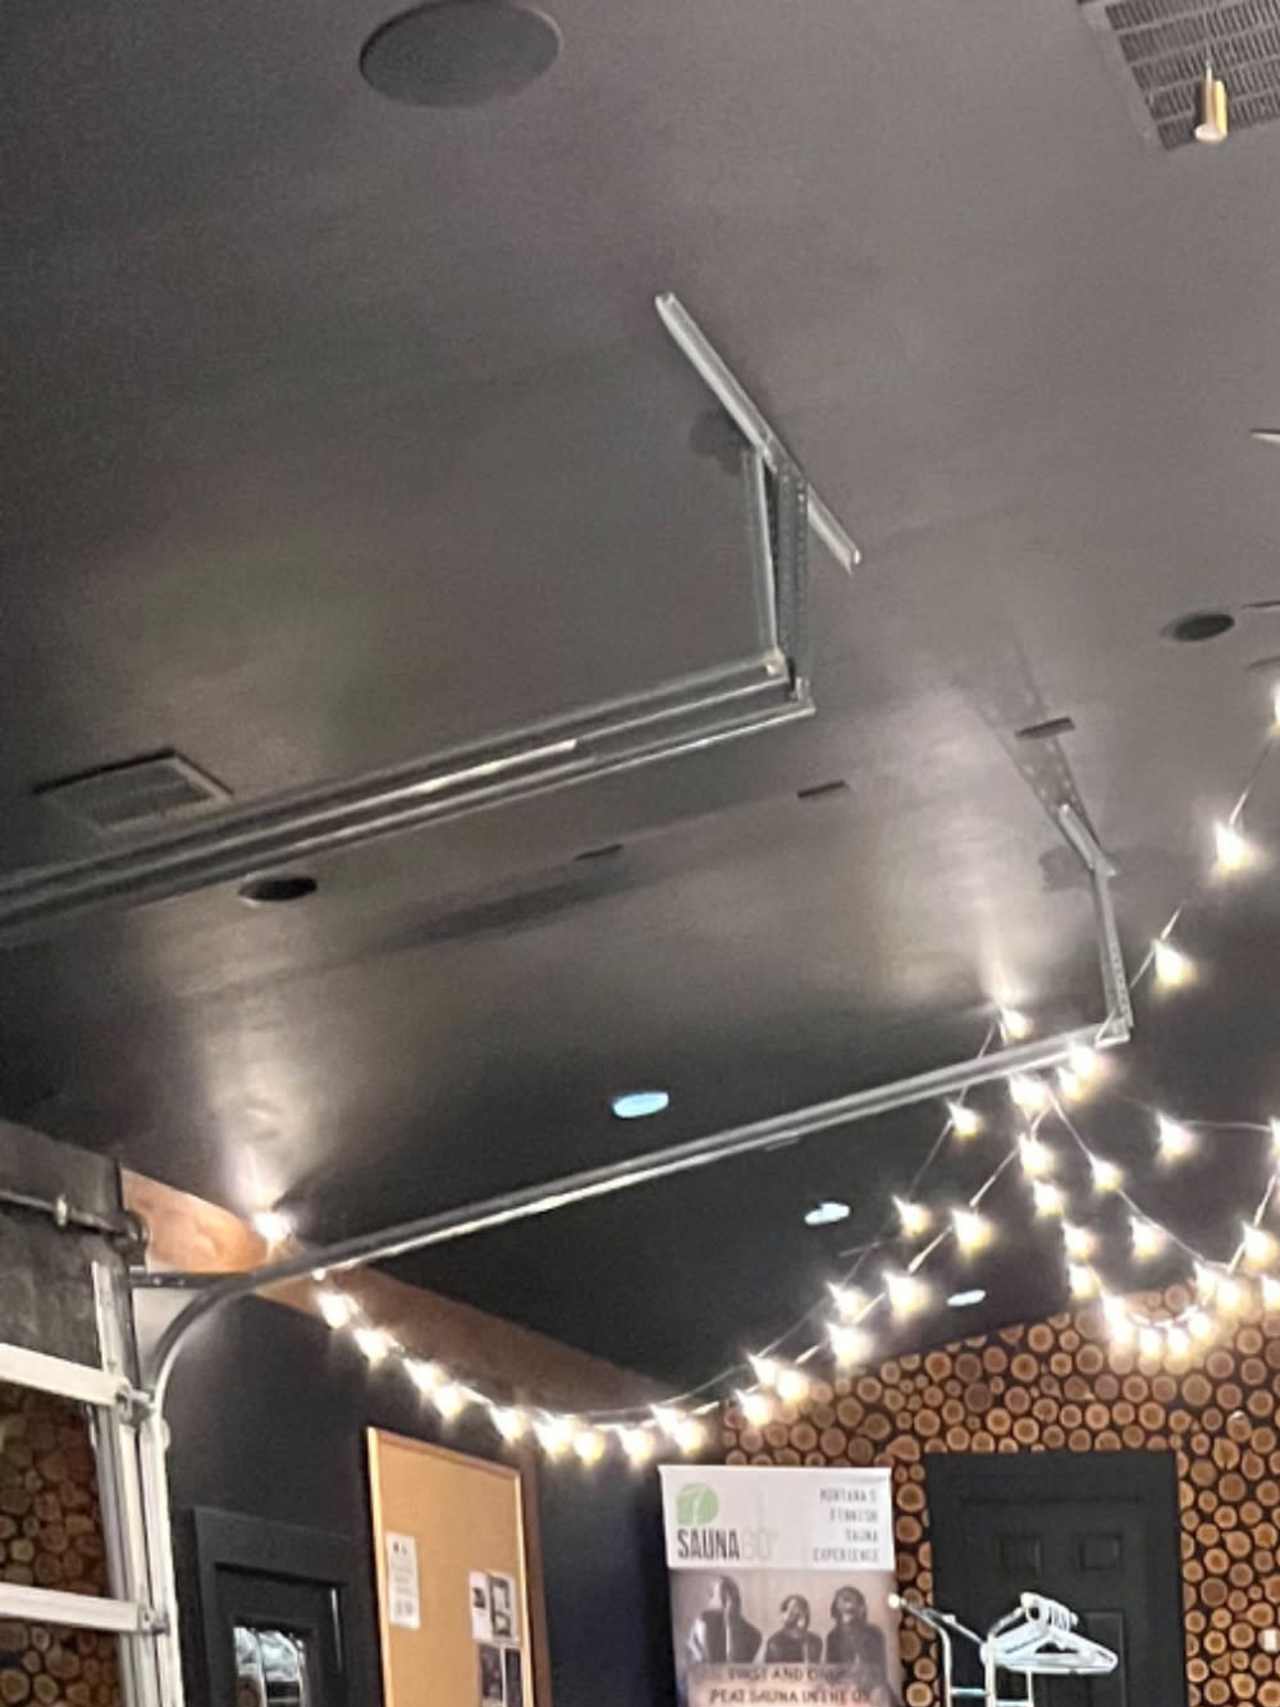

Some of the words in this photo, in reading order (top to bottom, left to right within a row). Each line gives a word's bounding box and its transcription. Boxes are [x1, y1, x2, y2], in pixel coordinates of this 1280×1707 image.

[677, 1528, 740, 1560] SAUNA
[773, 1666, 806, 1682] AND
[709, 1688, 745, 1705] PEAT
[749, 1688, 798, 1705] SAUNA
